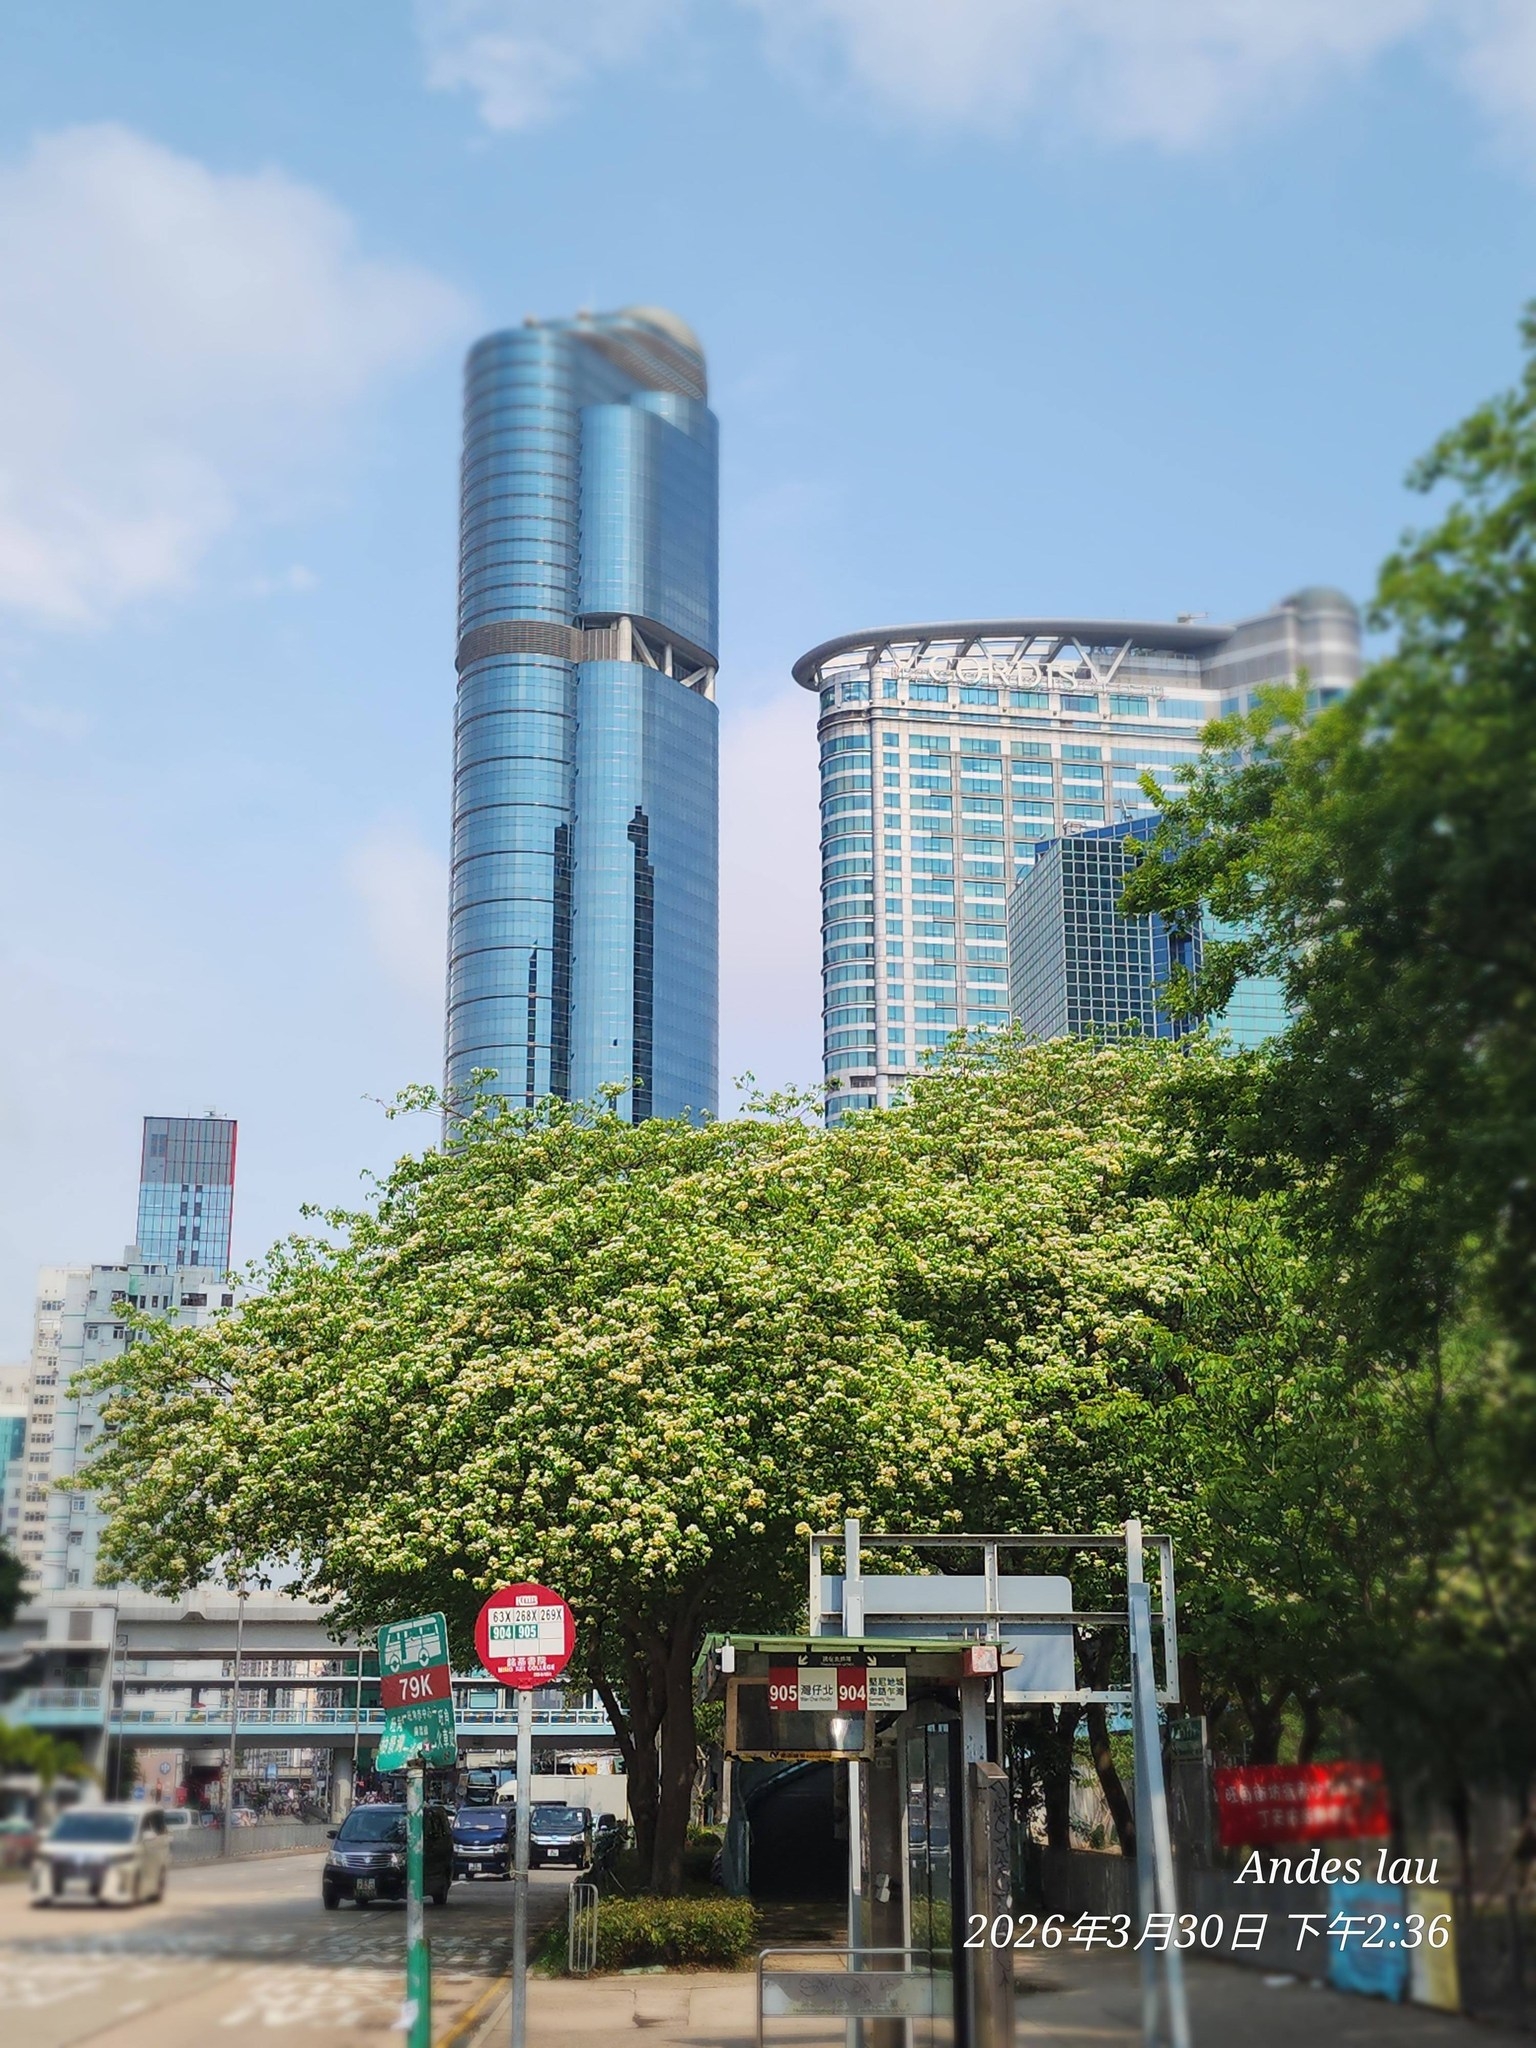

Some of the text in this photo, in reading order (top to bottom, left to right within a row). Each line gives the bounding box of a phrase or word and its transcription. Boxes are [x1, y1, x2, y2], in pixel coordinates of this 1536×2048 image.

[929, 656, 1079, 691] CORDIS
[493, 1607, 562, 1623] 63X 268X 269X
[493, 1625, 537, 1639] 904 905
[527, 1663, 555, 1672] COLLEGE
[399, 1673, 433, 1700] 79K
[869, 1677, 904, 1686] 堅尼地城
[769, 1685, 797, 1702] 905
[801, 1684, 833, 1696] 灣仔北
[839, 1685, 866, 1701] 904
